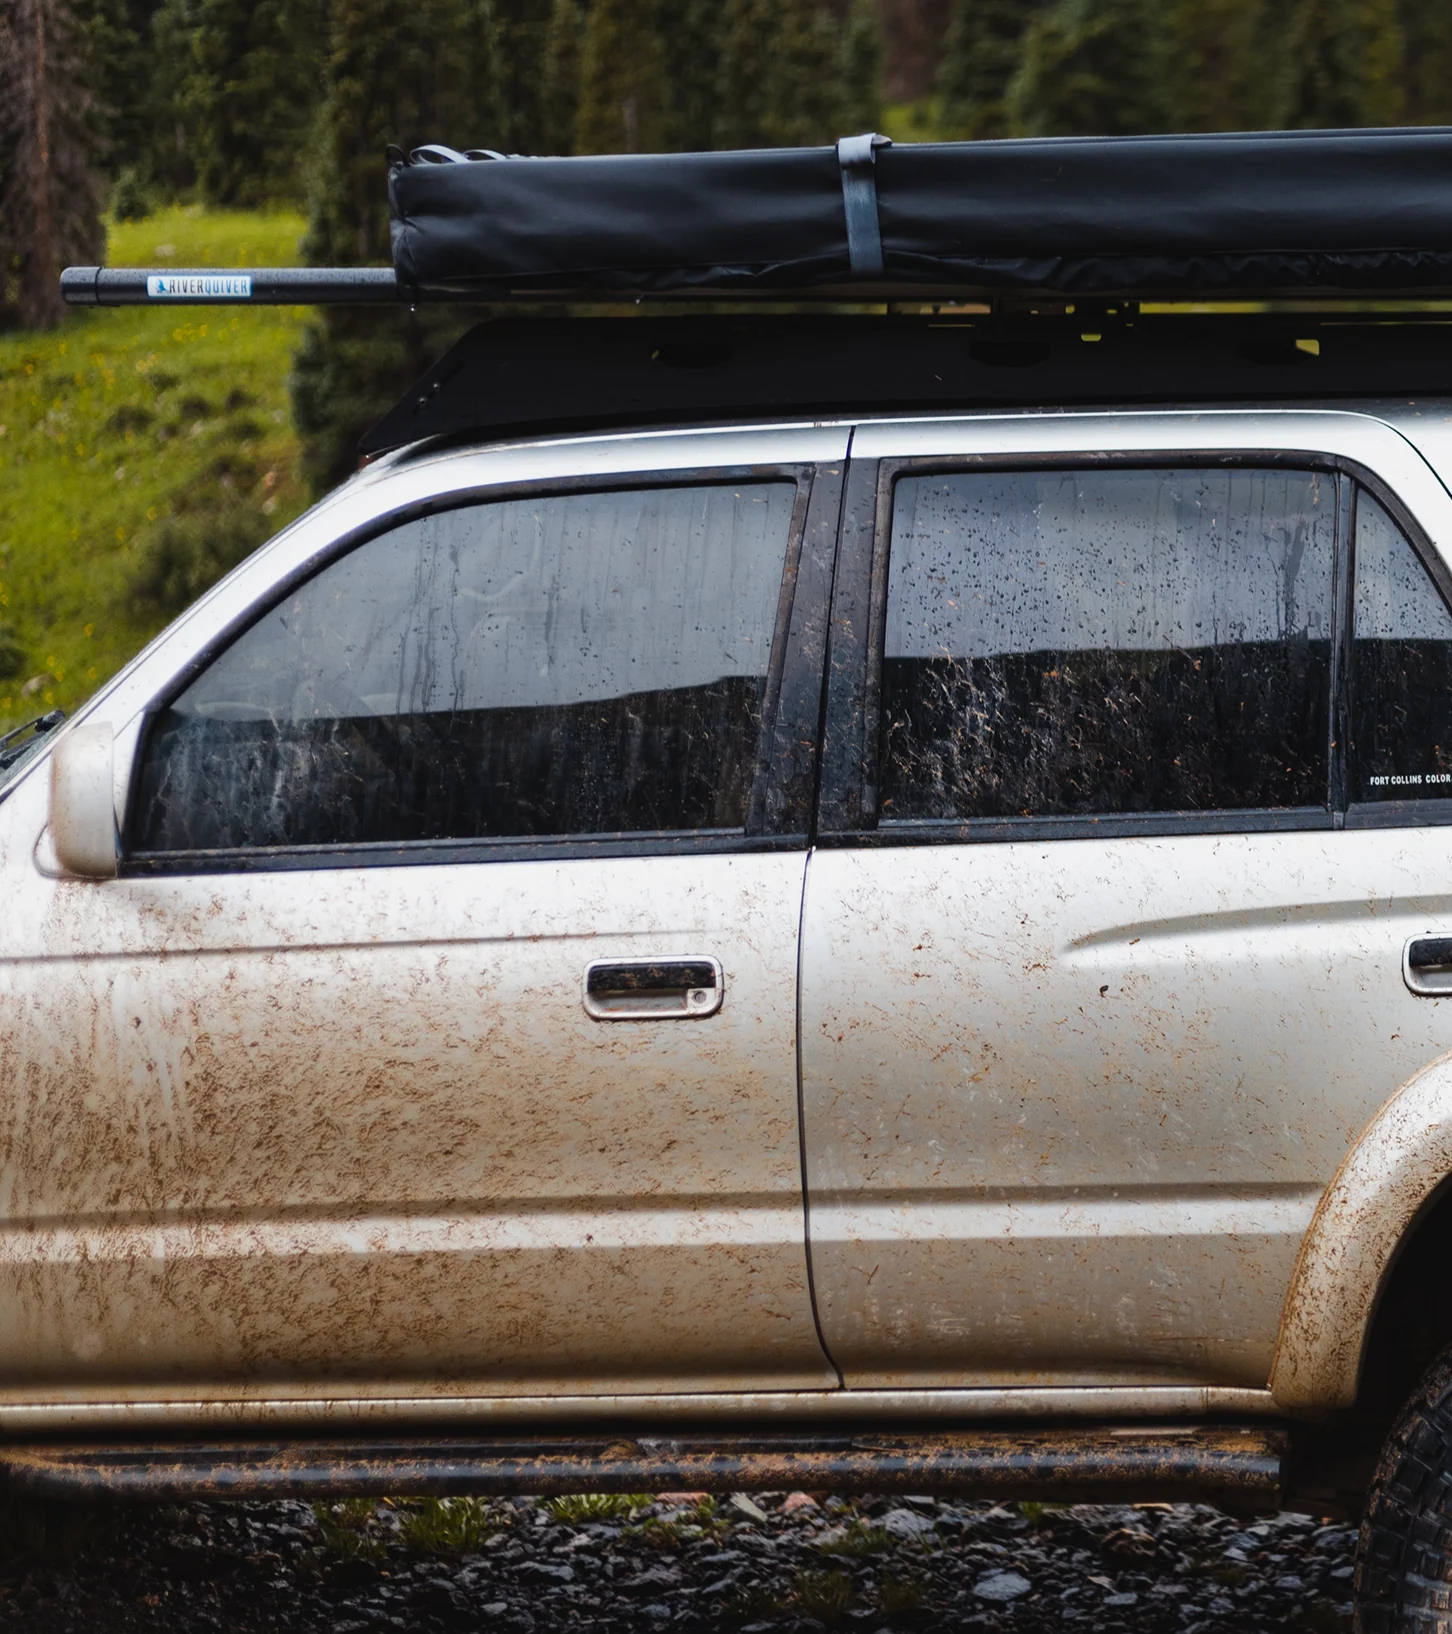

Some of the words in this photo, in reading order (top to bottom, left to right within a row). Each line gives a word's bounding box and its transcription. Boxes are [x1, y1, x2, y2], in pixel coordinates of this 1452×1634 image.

[169, 279, 248, 294] RIVERQUIVER
[1370, 775, 1390, 786] FORT
[1391, 774, 1422, 785] COLLINS
